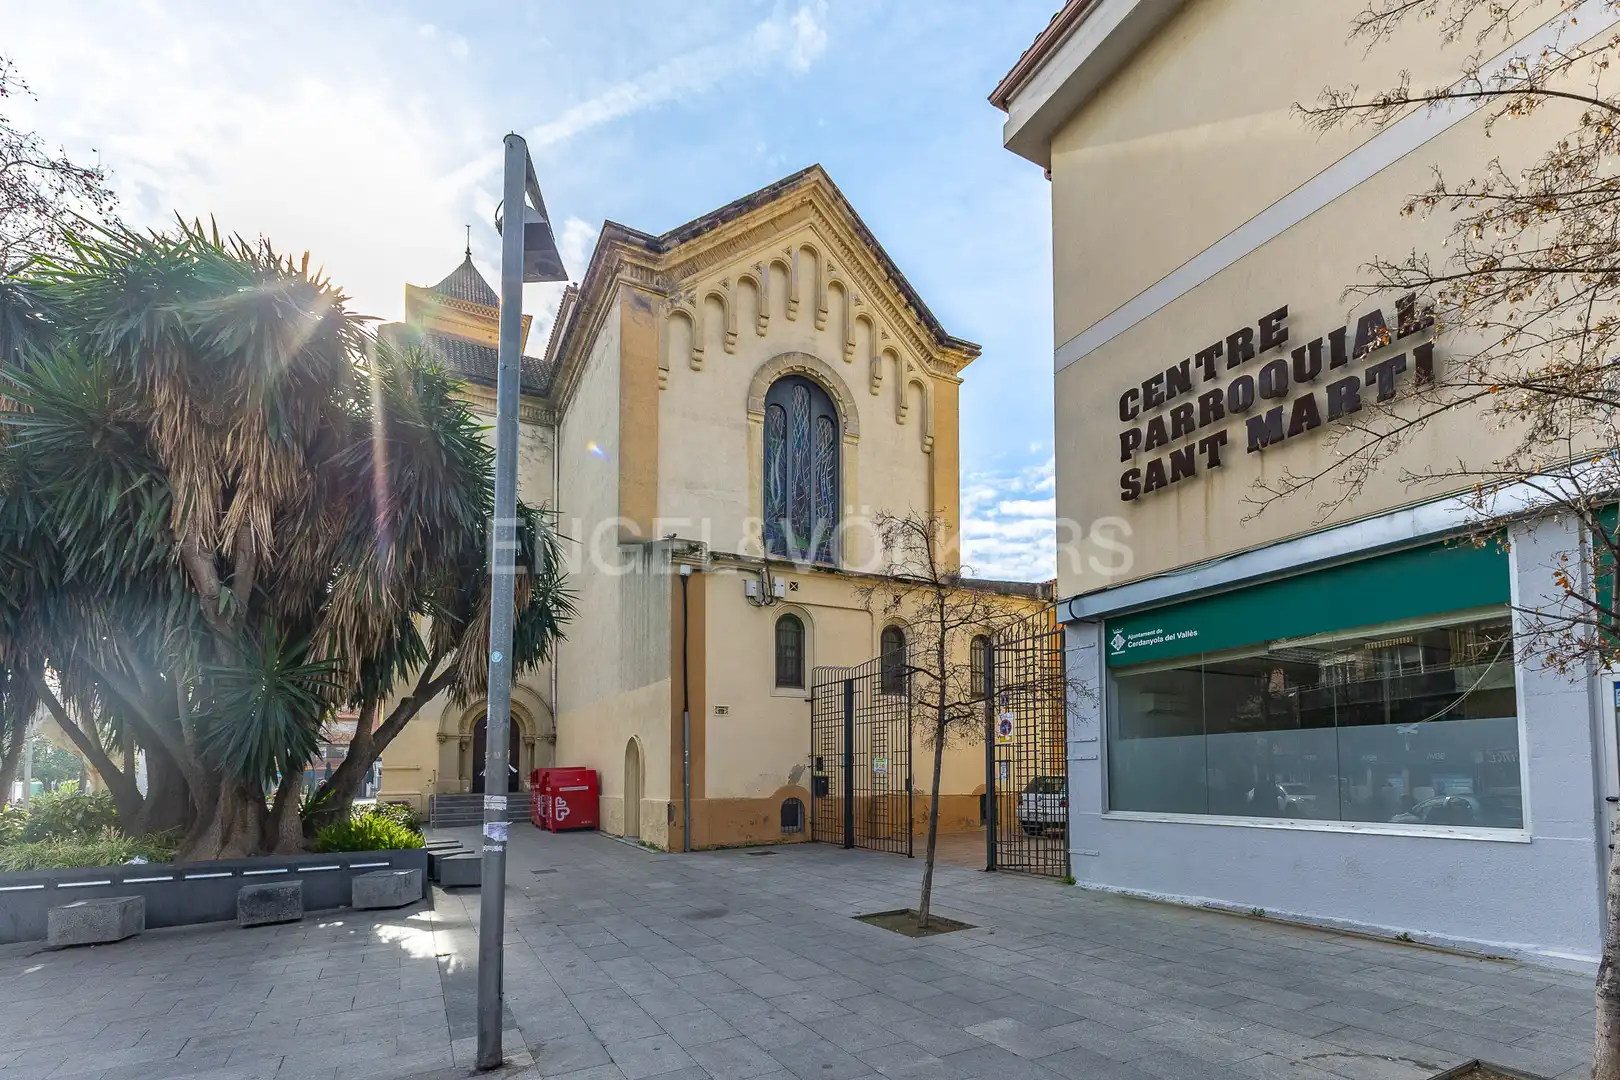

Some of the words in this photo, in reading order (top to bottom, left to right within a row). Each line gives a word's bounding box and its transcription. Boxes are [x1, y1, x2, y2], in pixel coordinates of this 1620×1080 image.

[1119, 304, 1289, 422] CENTRE
[1119, 292, 1435, 463] PARROQUIAL
[1120, 429, 1228, 501] SANT
[1246, 342, 1435, 454] MARTI
[1127, 629, 1156, 641] Ajuntament
[1127, 636, 1164, 648] Cerdanyola
[1165, 633, 1176, 642] del
[1176, 629, 1198, 640] Vallès
